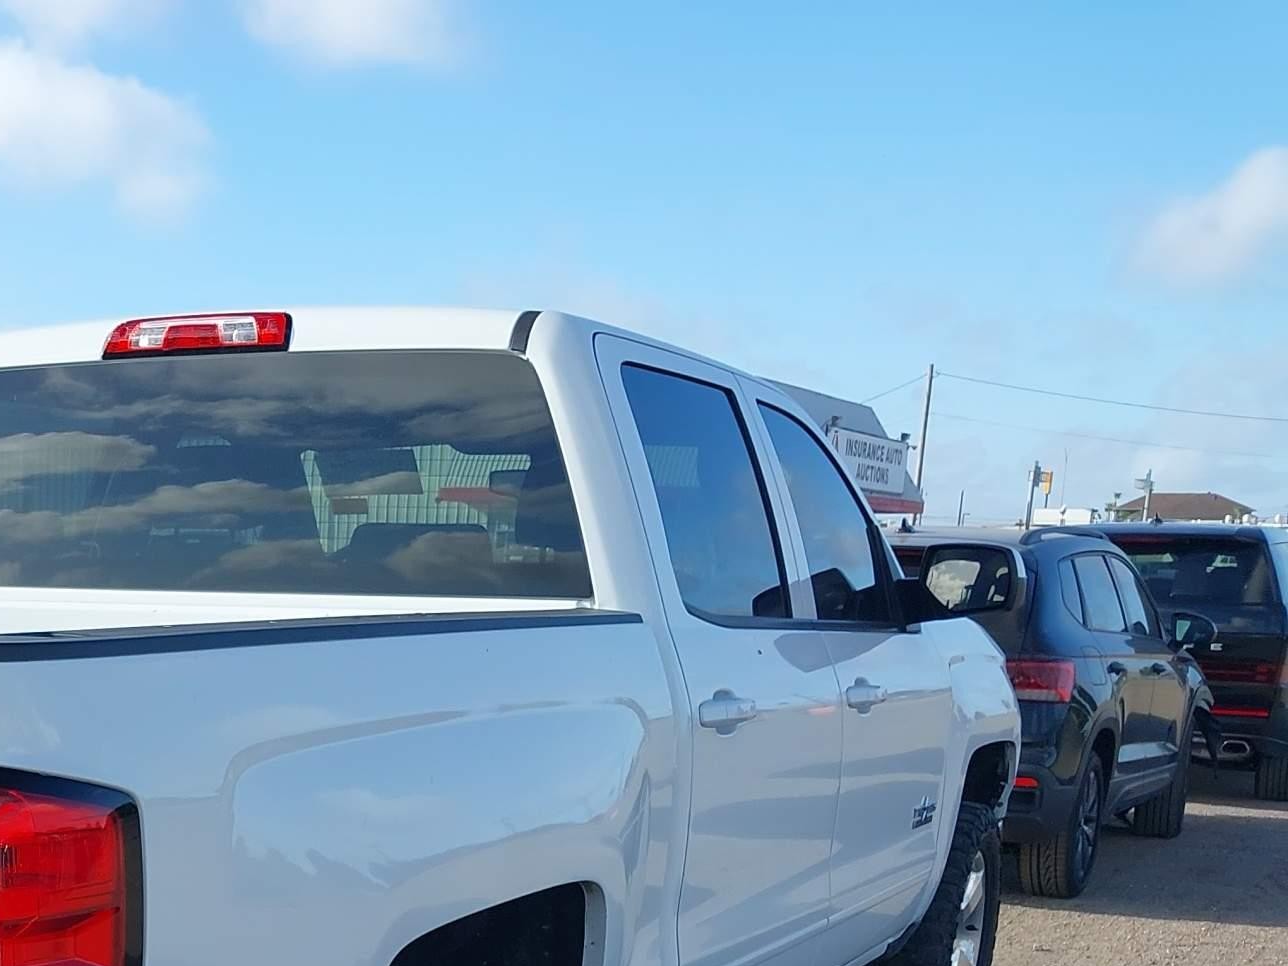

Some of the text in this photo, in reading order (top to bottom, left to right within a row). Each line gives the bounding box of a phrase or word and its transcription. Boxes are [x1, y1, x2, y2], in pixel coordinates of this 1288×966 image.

[845, 438, 885, 462] INSURANCE
[885, 447, 903, 466] AUTO
[855, 463, 889, 485] AUCTIONS
